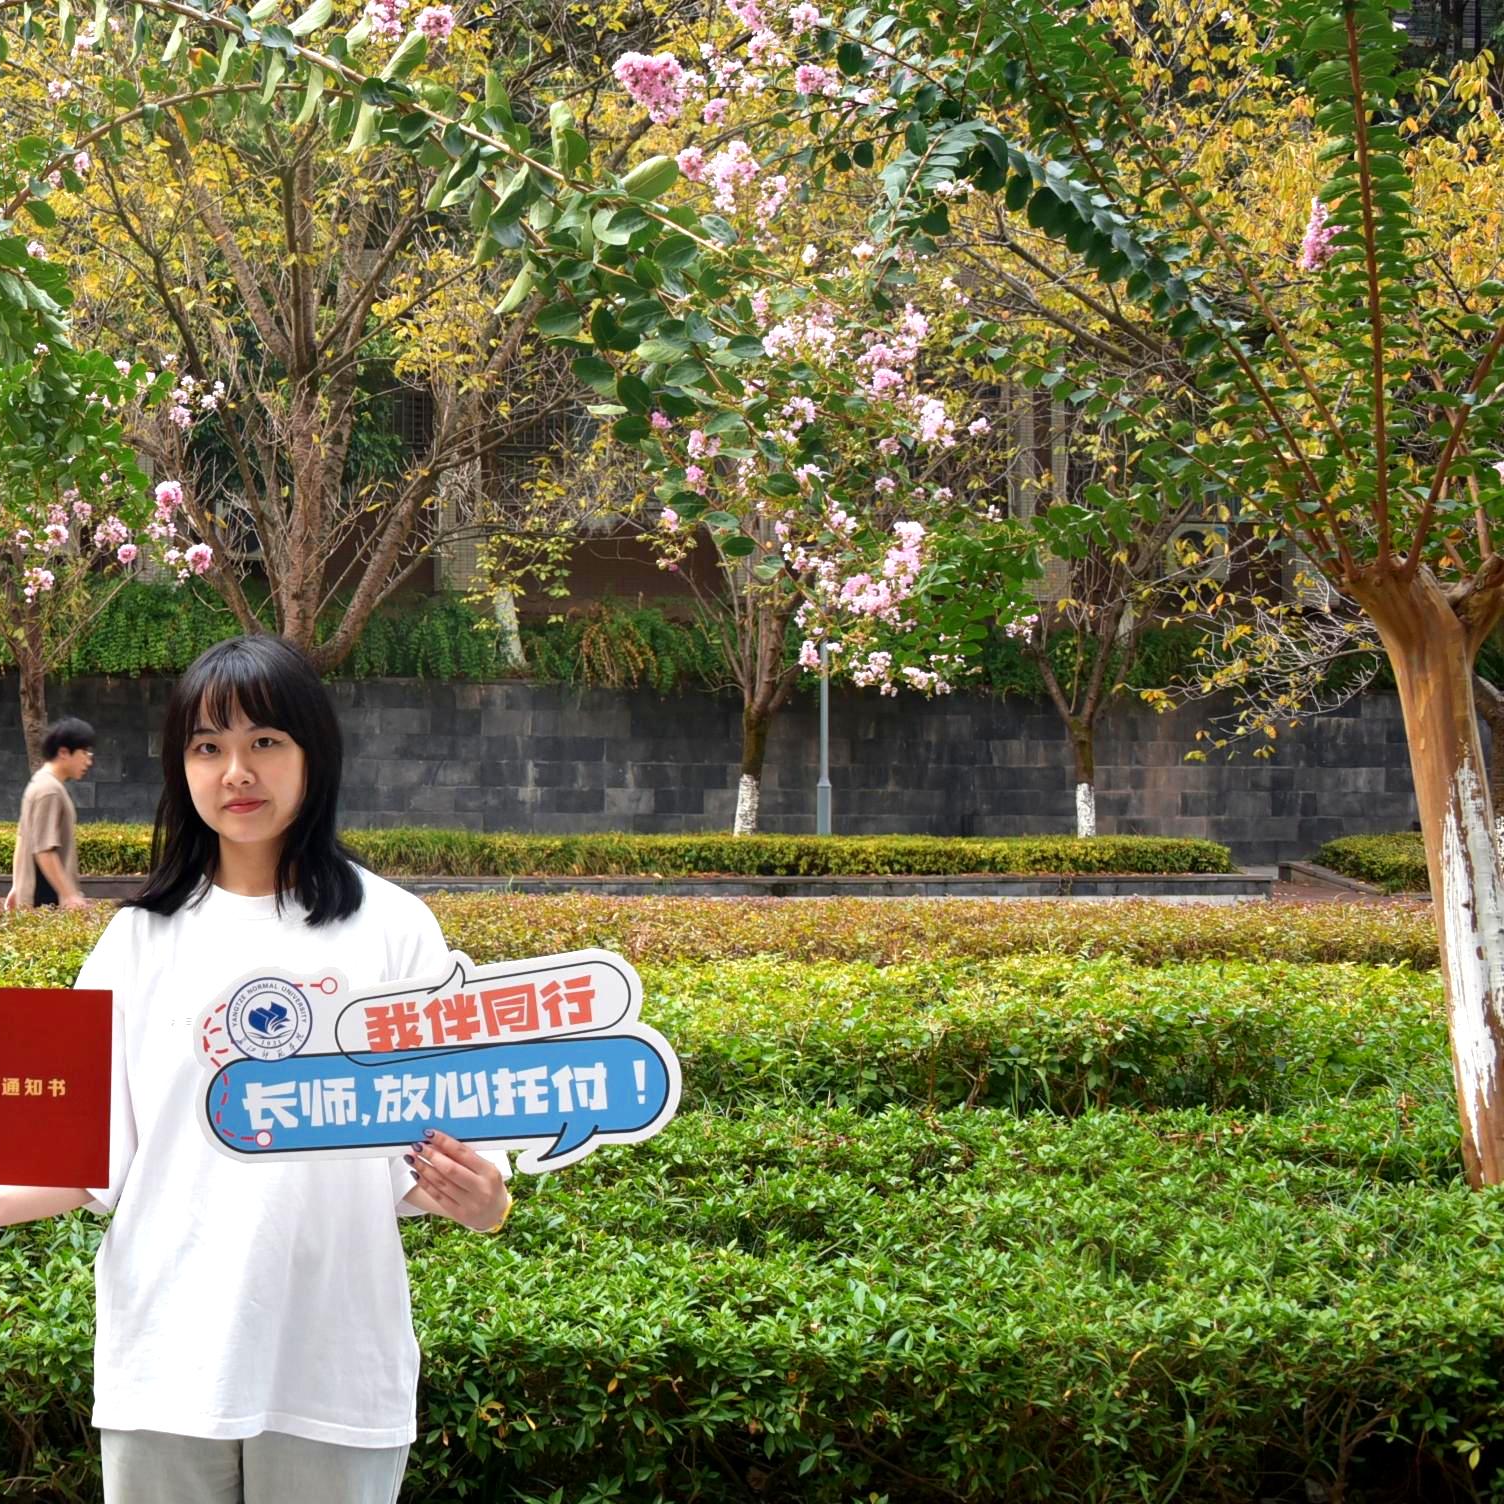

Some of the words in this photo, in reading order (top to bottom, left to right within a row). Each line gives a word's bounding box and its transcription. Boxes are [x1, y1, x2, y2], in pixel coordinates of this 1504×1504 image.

[232, 995, 247, 1027] YANGTZE
[247, 983, 278, 995] NORMAL
[281, 986, 307, 1023] UNIVERSITY
[365, 975, 596, 1053] 我伴同行
